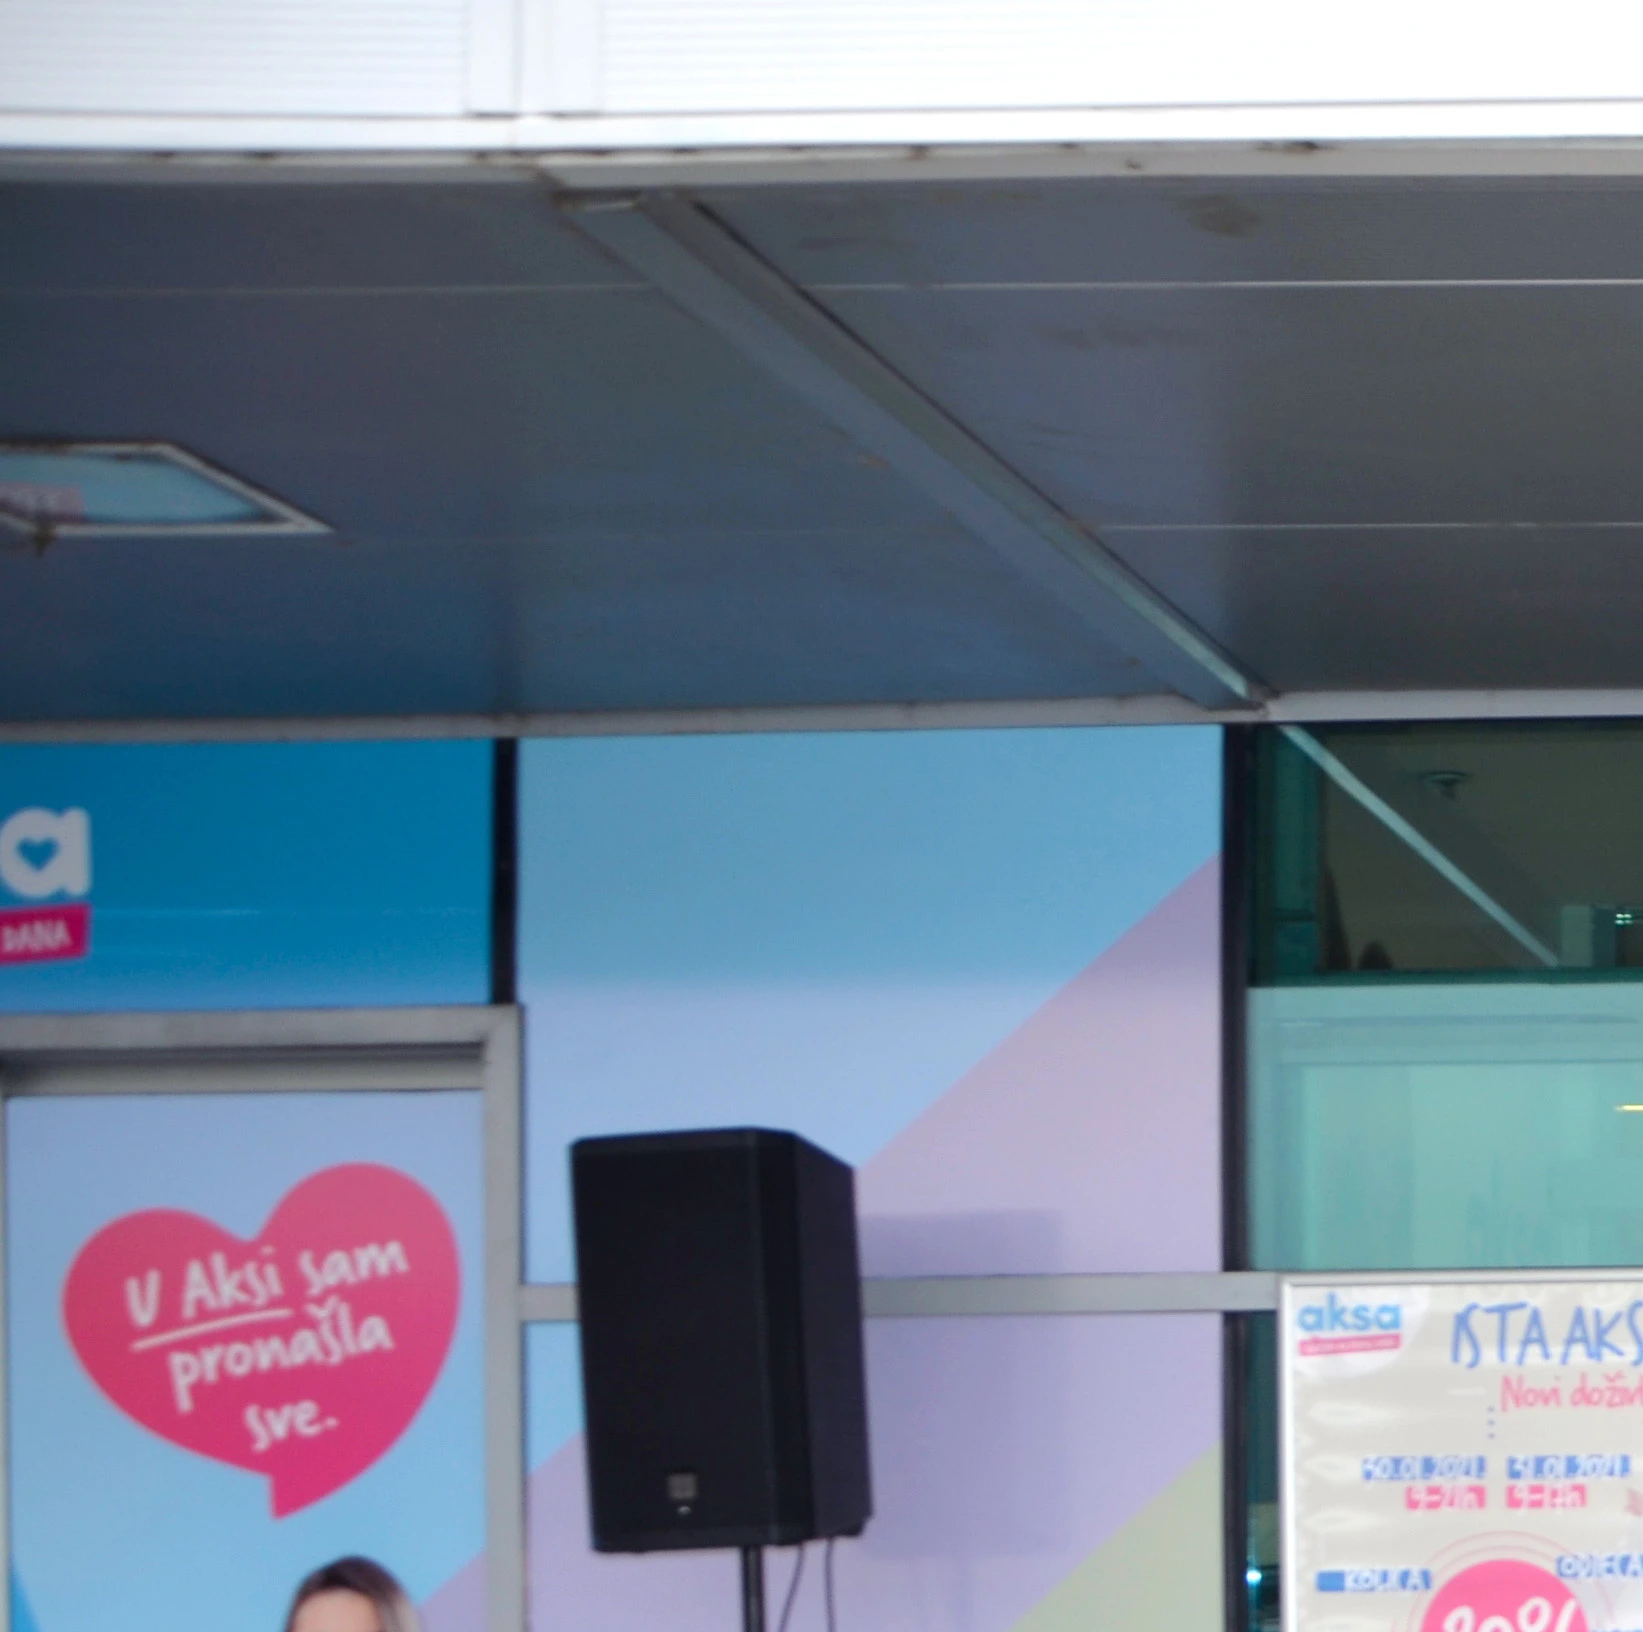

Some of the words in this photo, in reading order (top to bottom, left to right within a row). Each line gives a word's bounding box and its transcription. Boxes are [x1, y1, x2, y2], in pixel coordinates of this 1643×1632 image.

[125, 1269, 161, 1328] V
[181, 1247, 283, 1319] Aksi
[298, 1236, 408, 1297] sam
[1298, 1293, 1401, 1332] aksa
[168, 1301, 393, 1414] pronašla
[1501, 1373, 1561, 1412] Novi
[244, 1403, 339, 1452] sve.
